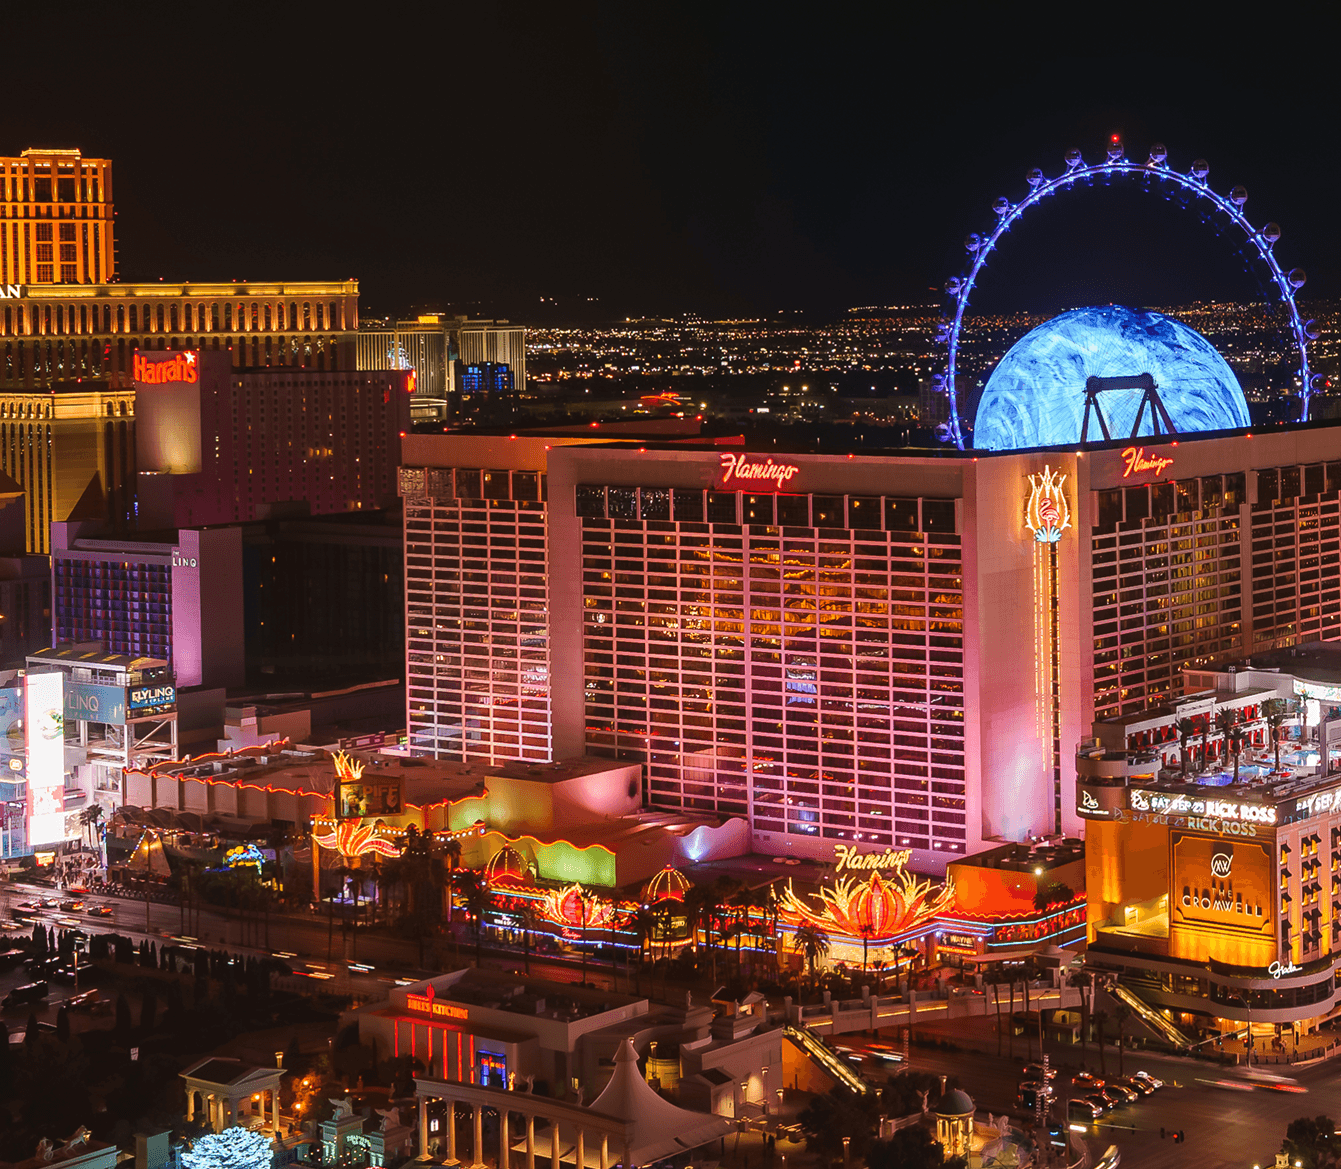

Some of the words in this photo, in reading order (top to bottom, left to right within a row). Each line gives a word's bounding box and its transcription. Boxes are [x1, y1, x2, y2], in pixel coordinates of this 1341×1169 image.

[720, 453, 799, 488] Flamingo
[1121, 447, 1173, 477] Flamingo
[172, 557, 197, 567] LINQ
[1151, 797, 1170, 808] SAT
[1206, 801, 1239, 818] RICK
[1240, 805, 1276, 823] ROSS
[834, 844, 913, 874] Flamingo
[1211, 887, 1233, 898] THE
[1182, 895, 1262, 918] CROMWELL
[432, 1003, 469, 1020] KITCHEN
